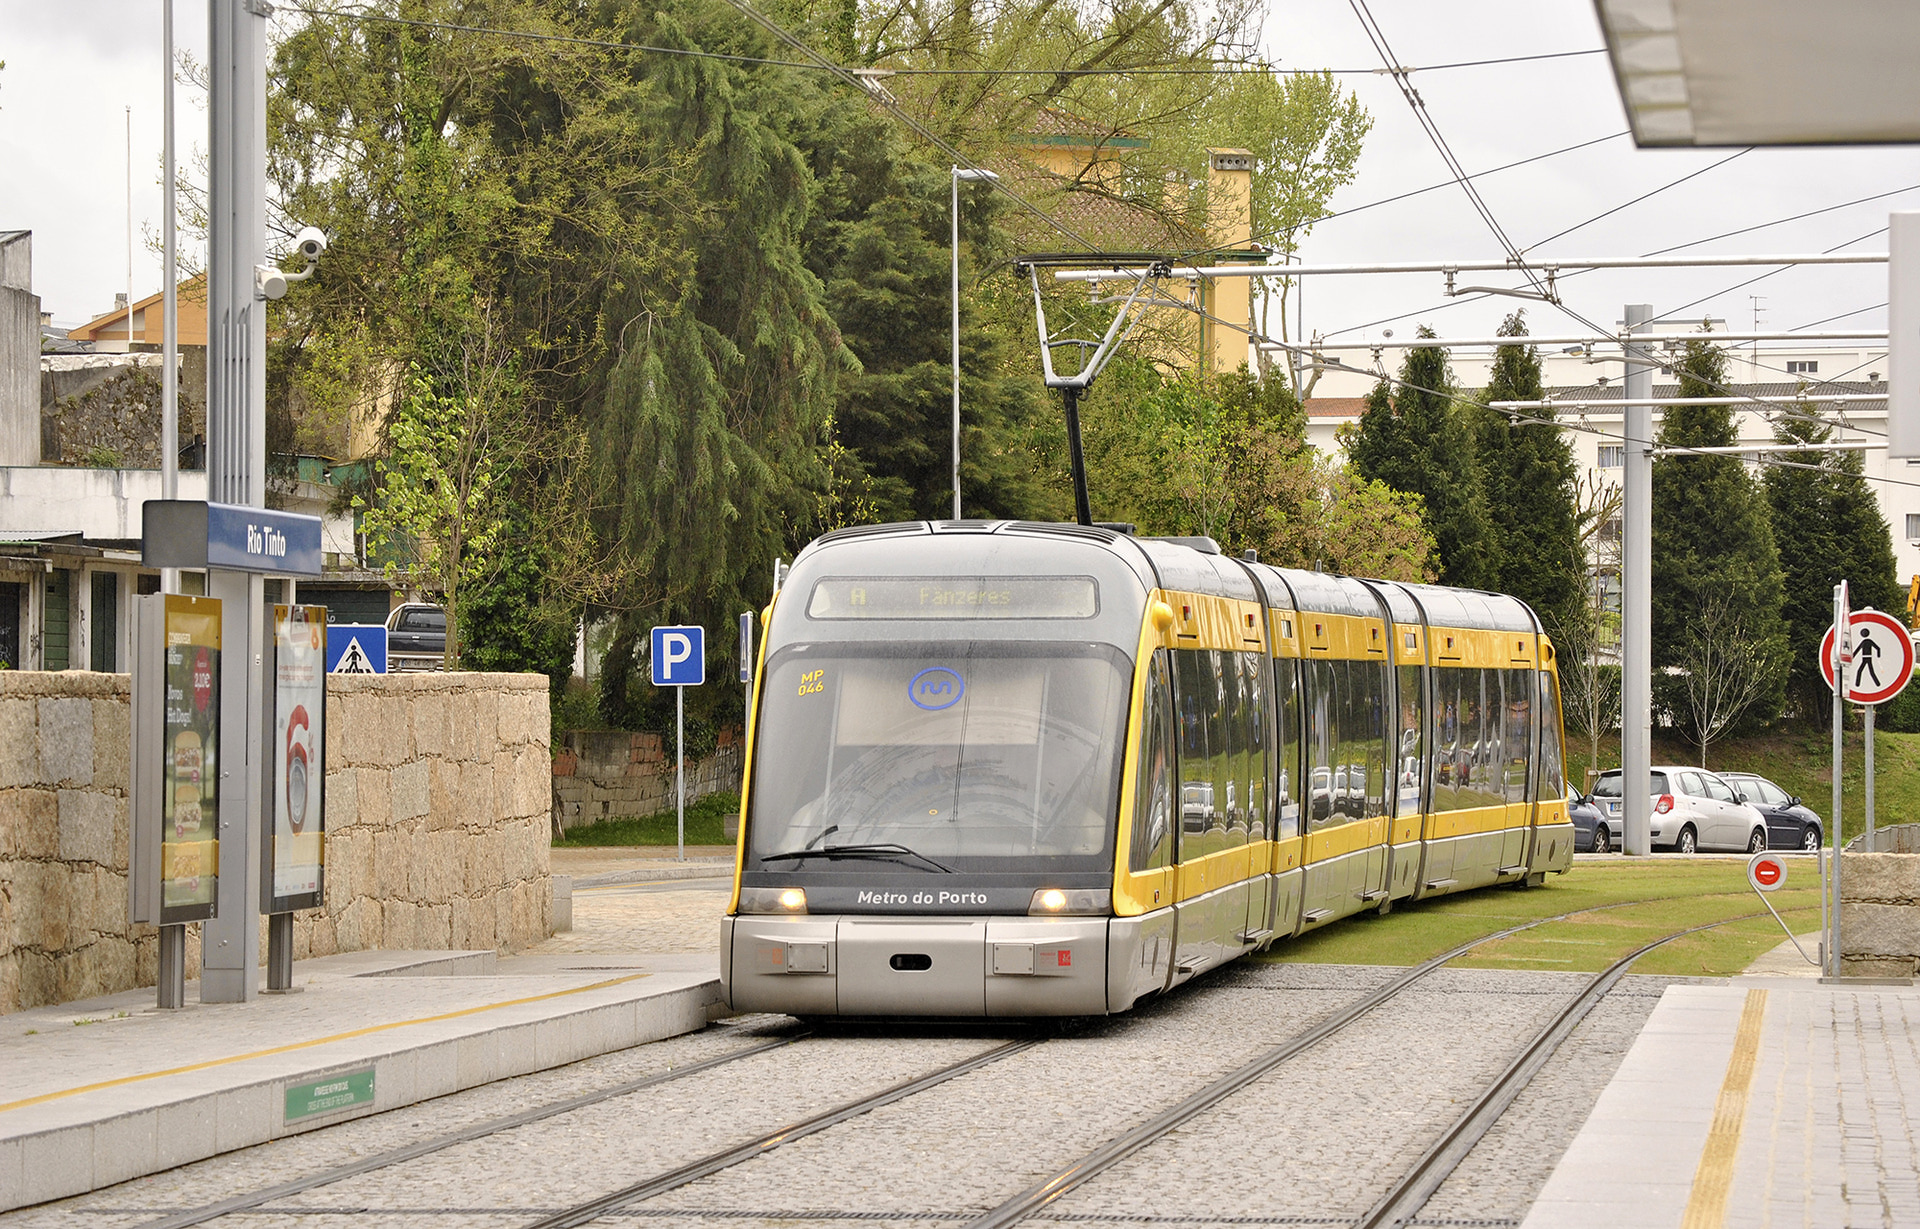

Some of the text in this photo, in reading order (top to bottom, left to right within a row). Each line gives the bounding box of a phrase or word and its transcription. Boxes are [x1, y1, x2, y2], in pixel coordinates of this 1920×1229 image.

[247, 524, 286, 557] Rio Tinto
[850, 587, 866, 606] A
[662, 633, 692, 680] P
[801, 669, 824, 684] MP
[798, 681, 824, 697] 046
[857, 890, 988, 905] Metro do Porto
